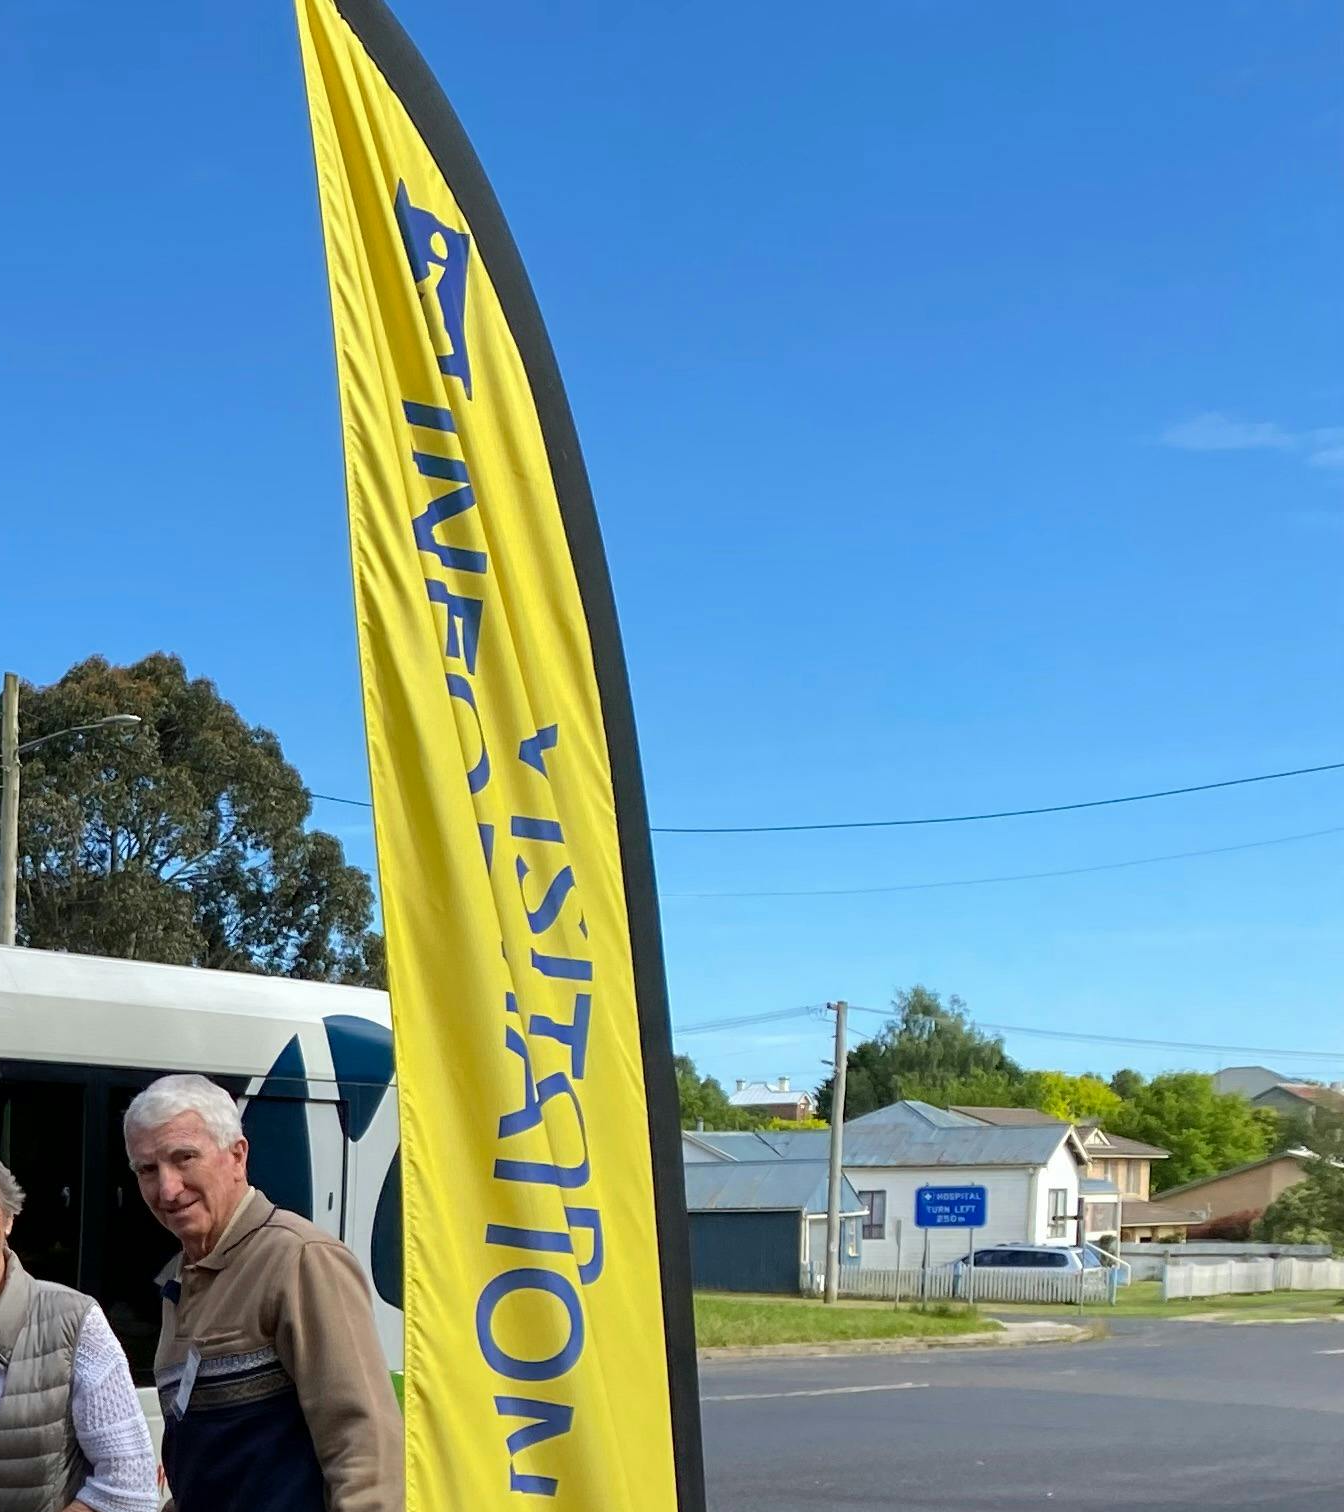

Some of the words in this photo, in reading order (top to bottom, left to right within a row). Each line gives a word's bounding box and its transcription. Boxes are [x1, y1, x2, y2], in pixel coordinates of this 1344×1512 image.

[936, 1192, 982, 1201] HOSPITAL
[926, 1205, 951, 1214] TURN
[954, 1204, 977, 1214] LEFT
